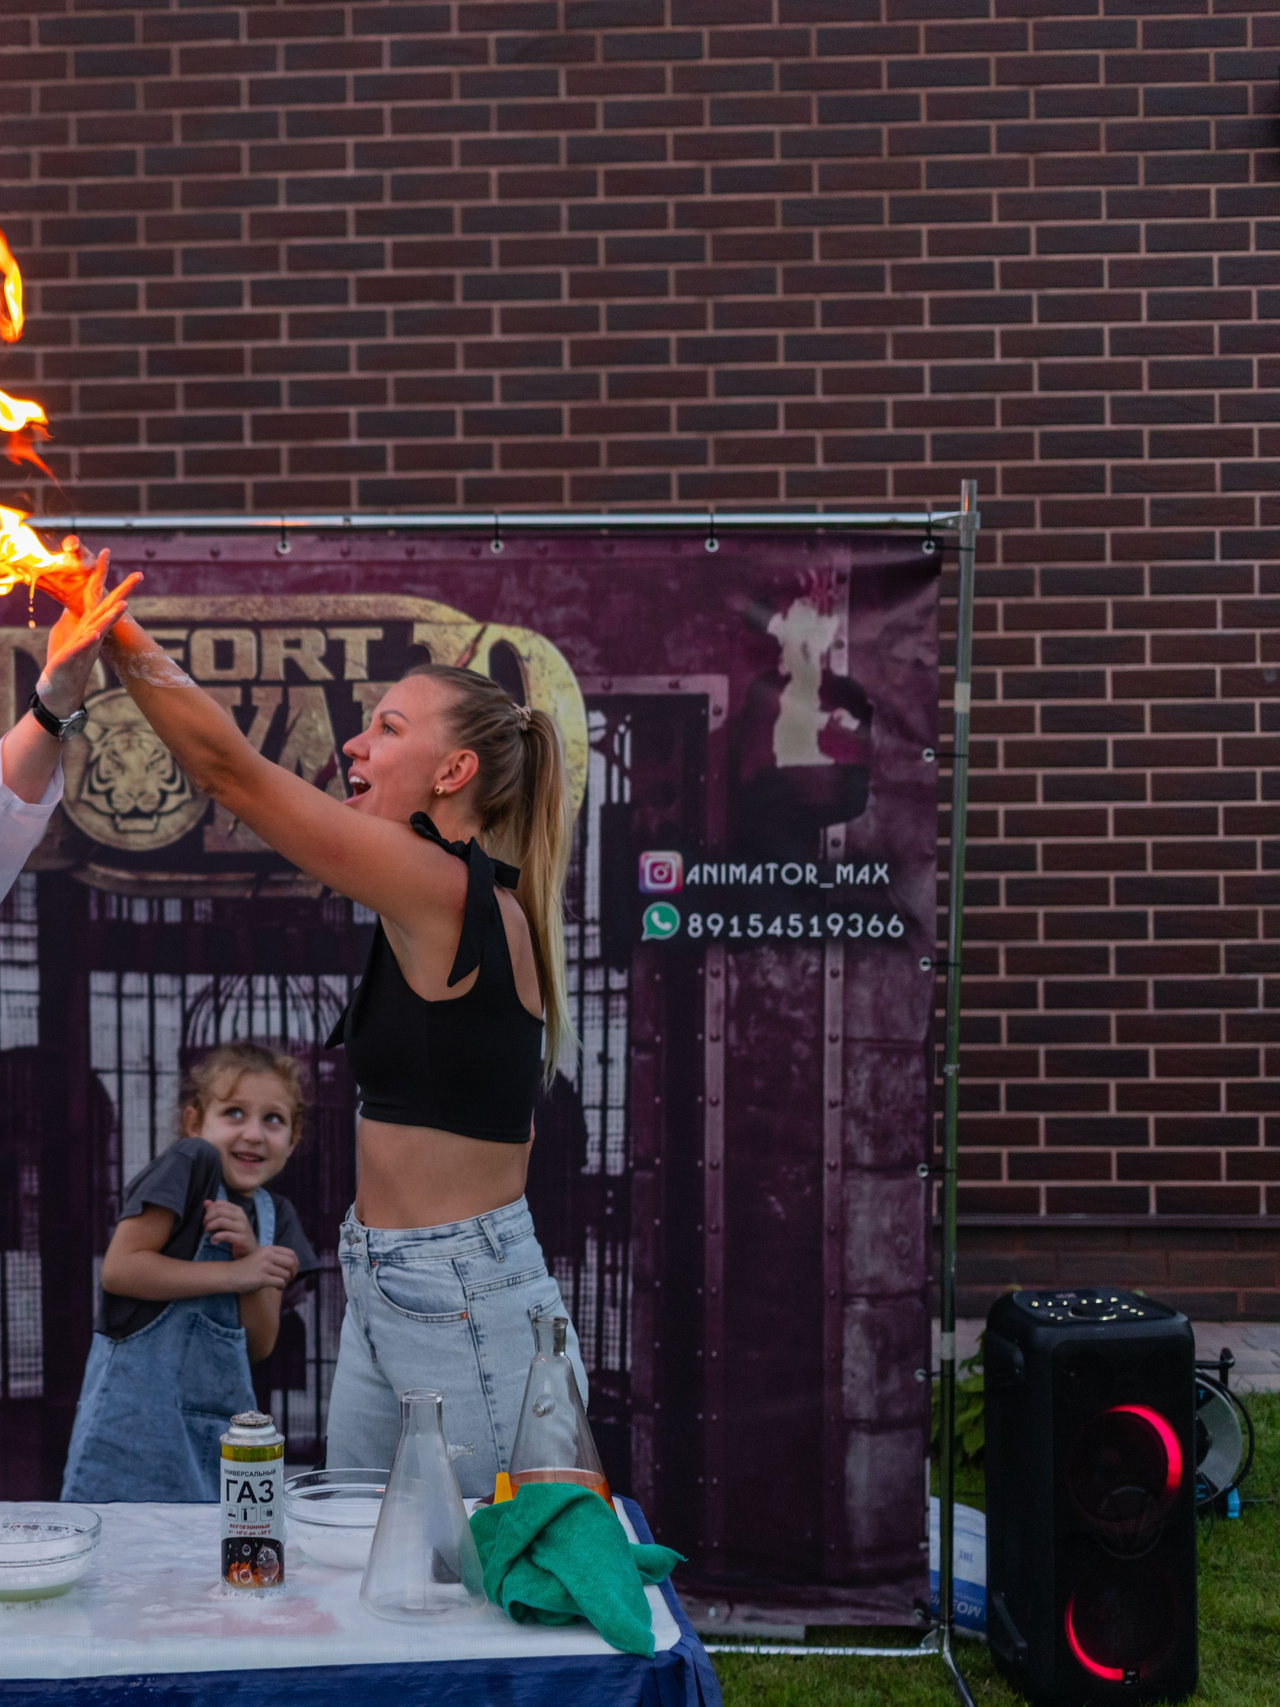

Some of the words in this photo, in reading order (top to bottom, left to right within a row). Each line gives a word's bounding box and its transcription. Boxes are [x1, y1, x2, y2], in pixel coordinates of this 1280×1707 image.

[685, 862, 890, 889] ANIMATOR_MAX
[686, 913, 905, 938] 89154519366
[224, 1468, 276, 1477] УНИВЕРСАЛЬНЫЙ
[226, 1479, 274, 1504] ГАЗ
